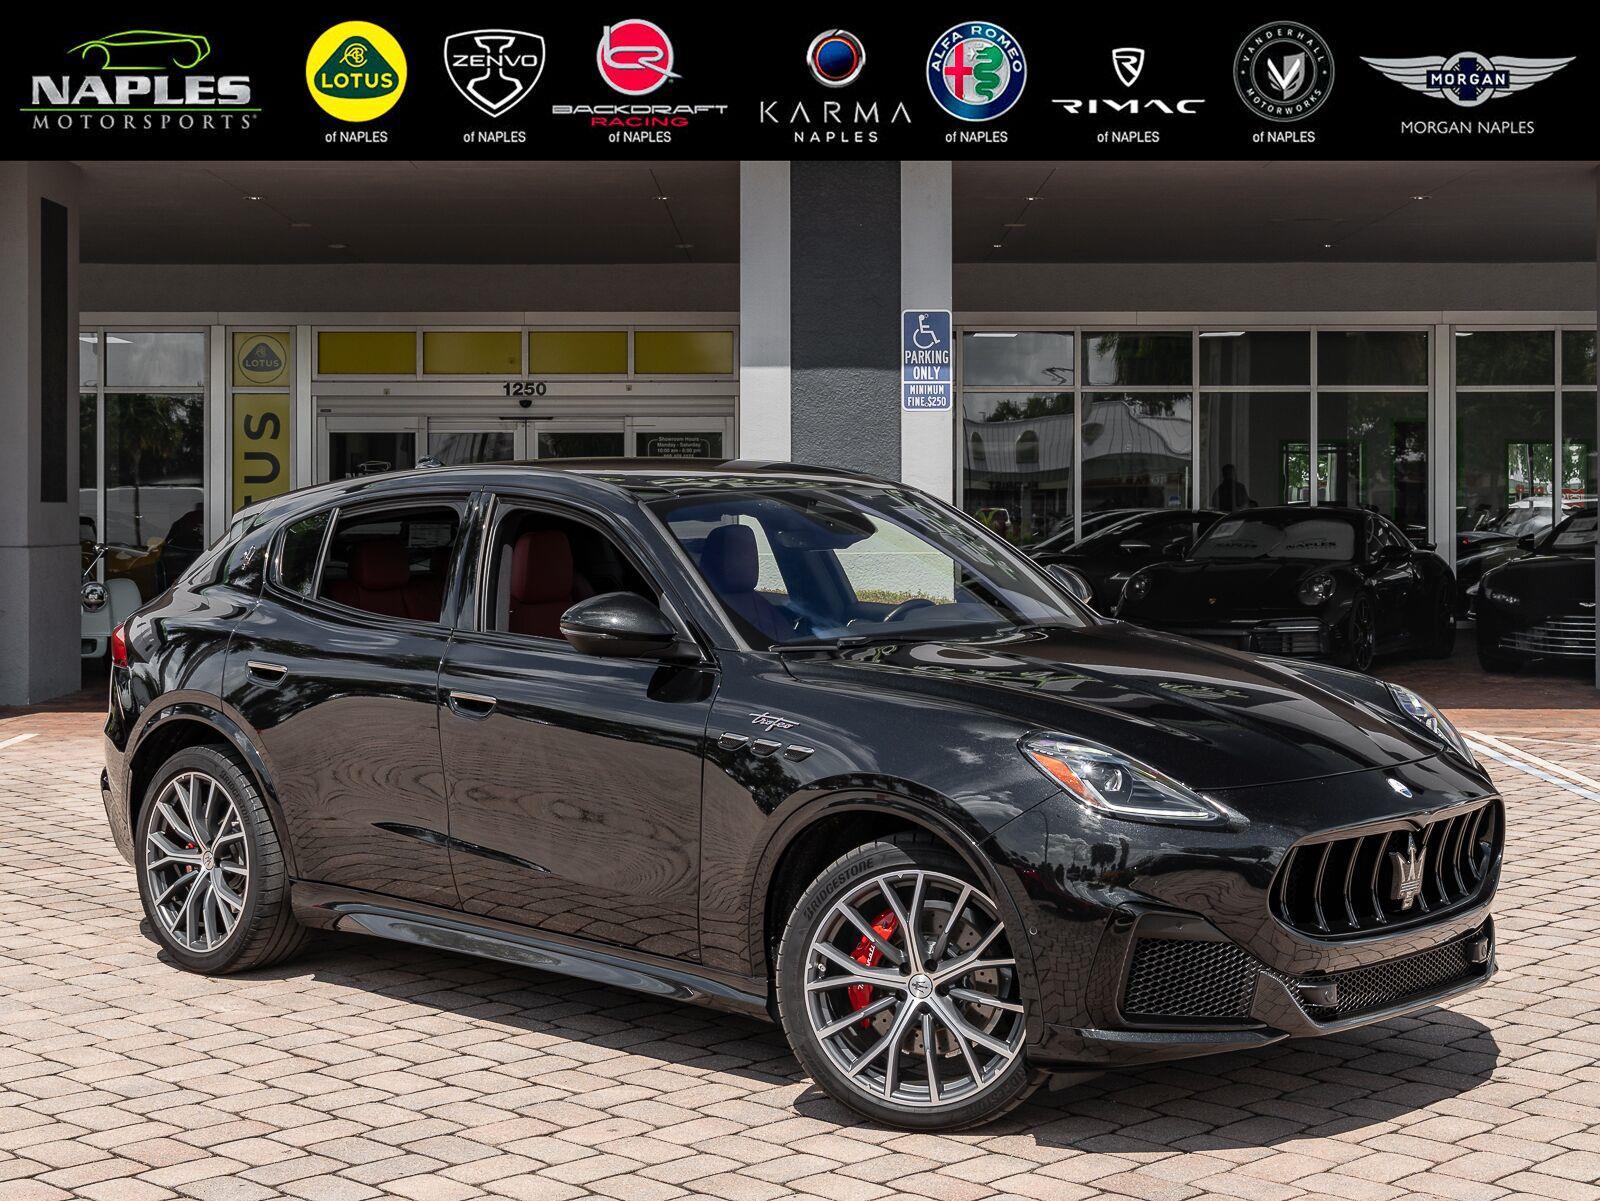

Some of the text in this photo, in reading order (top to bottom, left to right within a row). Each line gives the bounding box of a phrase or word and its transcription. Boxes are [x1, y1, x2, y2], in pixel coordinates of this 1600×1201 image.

[245, 359, 280, 368] LOTUS
[905, 350, 949, 364] PARKING
[913, 366, 940, 380] ONLY
[503, 382, 547, 396] 1250
[910, 385, 944, 395] MINIMUM
[908, 397, 925, 407] FINE
[804, 858, 875, 922] BRIDGESTONE
